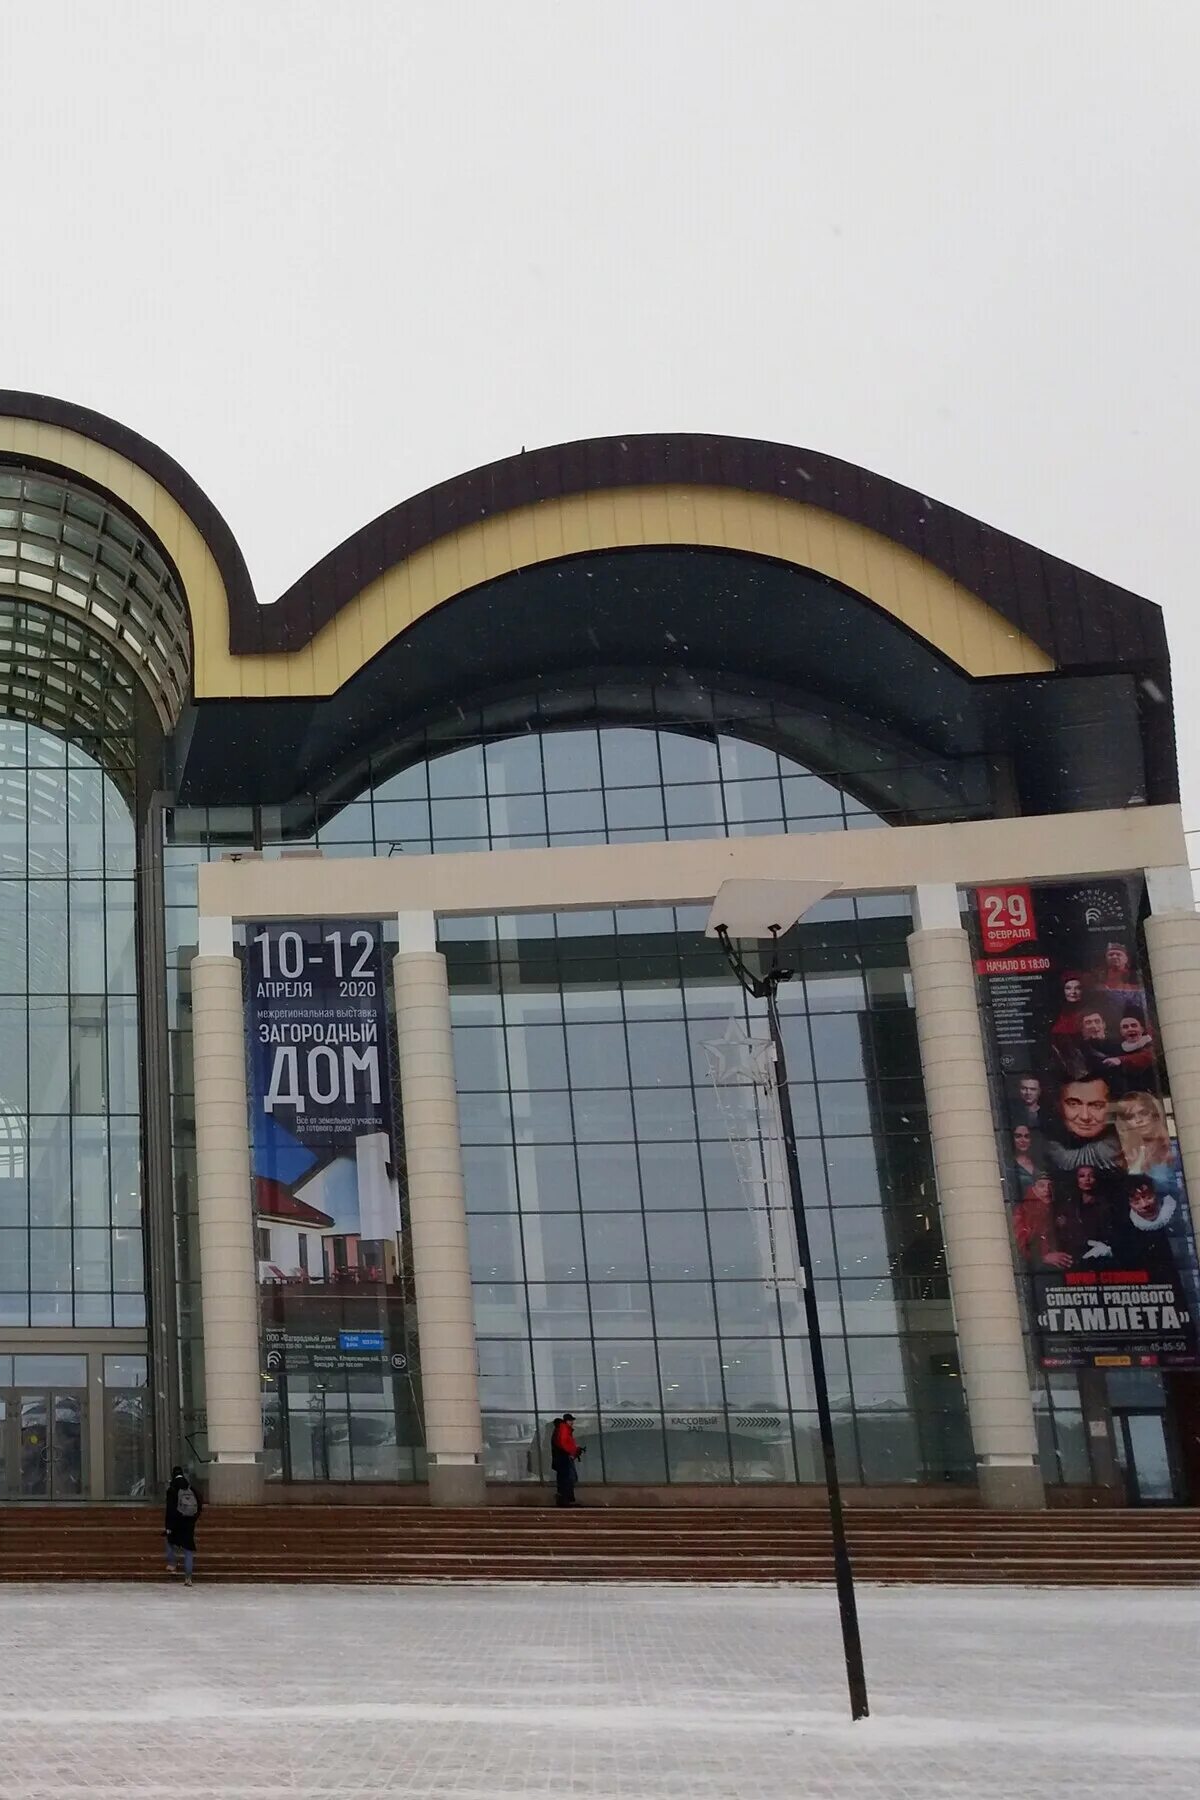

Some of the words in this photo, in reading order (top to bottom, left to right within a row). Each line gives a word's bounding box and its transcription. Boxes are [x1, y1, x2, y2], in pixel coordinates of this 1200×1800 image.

[984, 894, 1028, 928] 29
[988, 929, 1031, 940] ФЕВРАЛЯ
[253, 930, 376, 979] 10-12
[986, 960, 1018, 972] НАЧАЛО
[1020, 960, 1026, 970] В
[1028, 958, 1051, 969] 18:00
[256, 982, 313, 998] АПРЕЛЯ
[339, 981, 376, 997] 2020
[257, 1008, 335, 1020] межрегиональная
[336, 1008, 378, 1018] выставка
[259, 1019, 378, 1045] ЗАГОРОДНЫЙ
[263, 1045, 382, 1113] ДОМ
[1046, 1292, 1099, 1306] СПАСТИ
[1103, 1290, 1175, 1307] РЯДОВОГО
[1037, 1306, 1191, 1332] «ГАМЛЕТА»
[671, 1416, 718, 1425] КАССОВЫЙ
